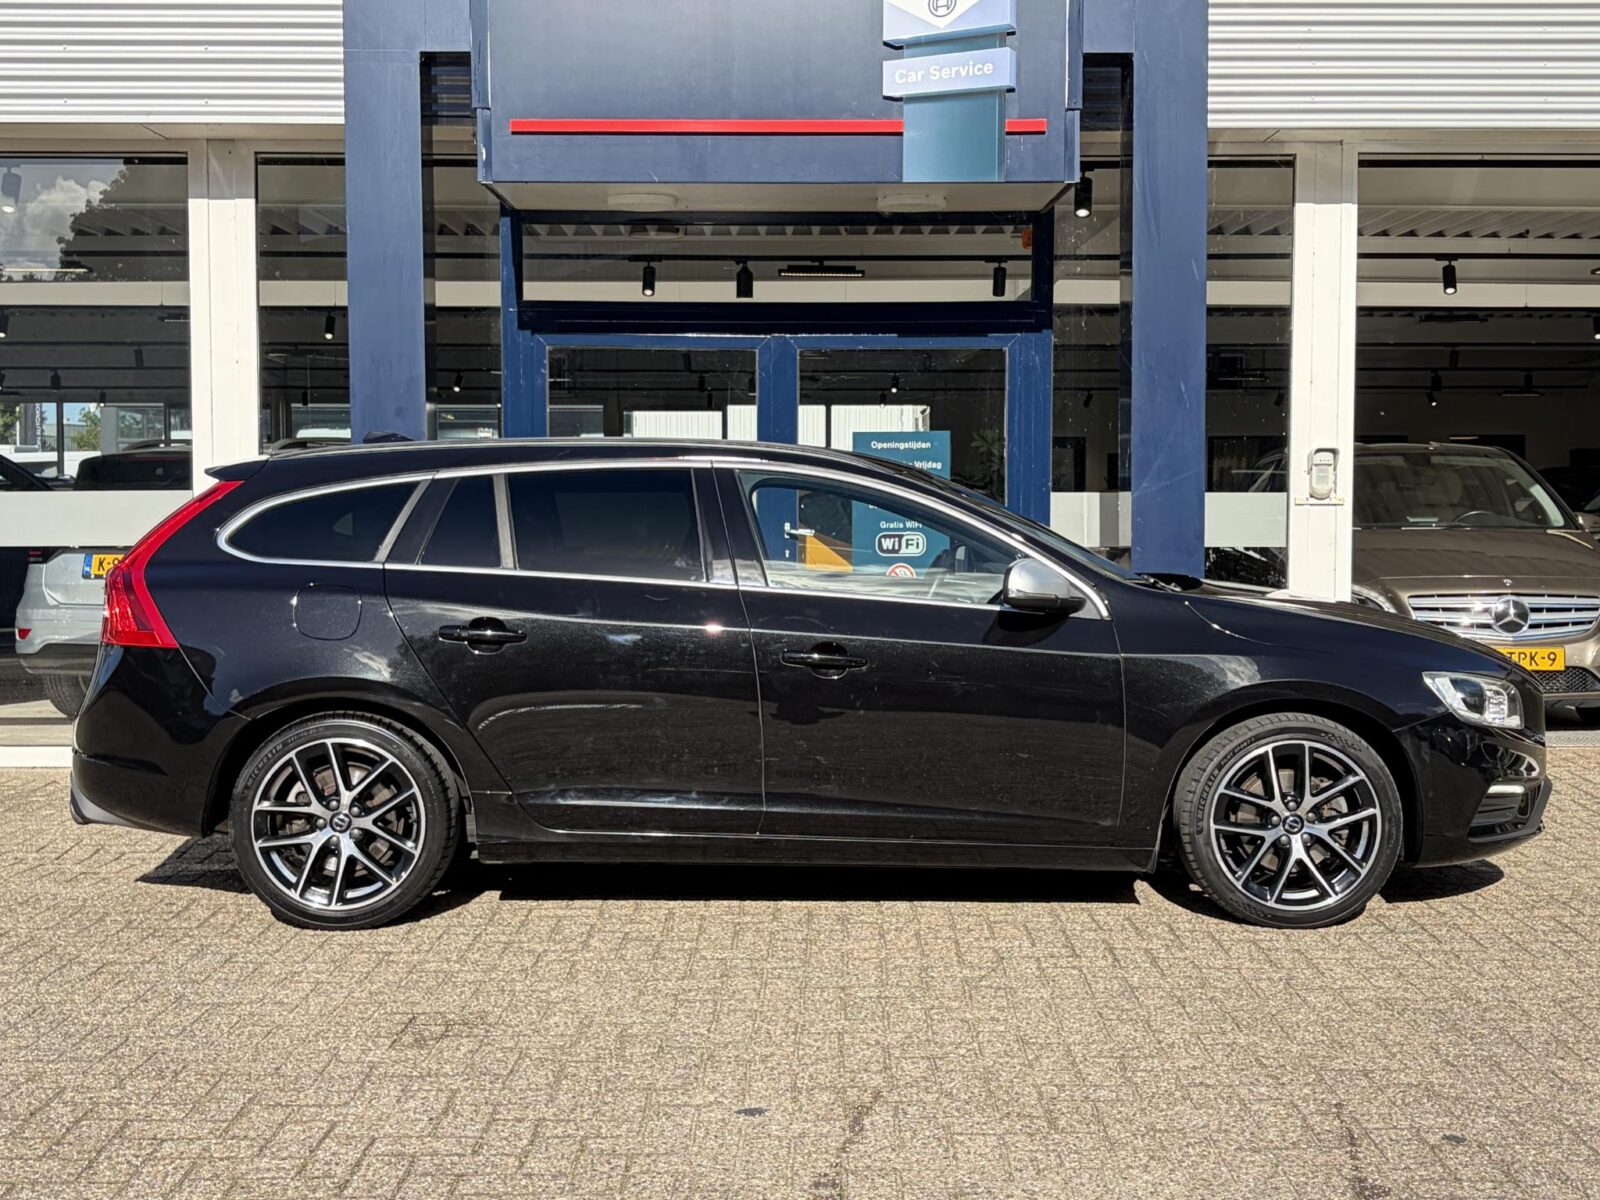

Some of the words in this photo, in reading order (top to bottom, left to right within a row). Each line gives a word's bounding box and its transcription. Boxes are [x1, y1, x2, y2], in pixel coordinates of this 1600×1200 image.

[894, 69, 924, 84] Car
[929, 61, 994, 80] Service
[870, 440, 932, 450] Openingstijden
[914, 460, 943, 470] Vrijdag
[880, 520, 904, 529] Gratis
[246, 743, 283, 787] MICHELIN
[1196, 768, 1220, 819] MICHELIN
